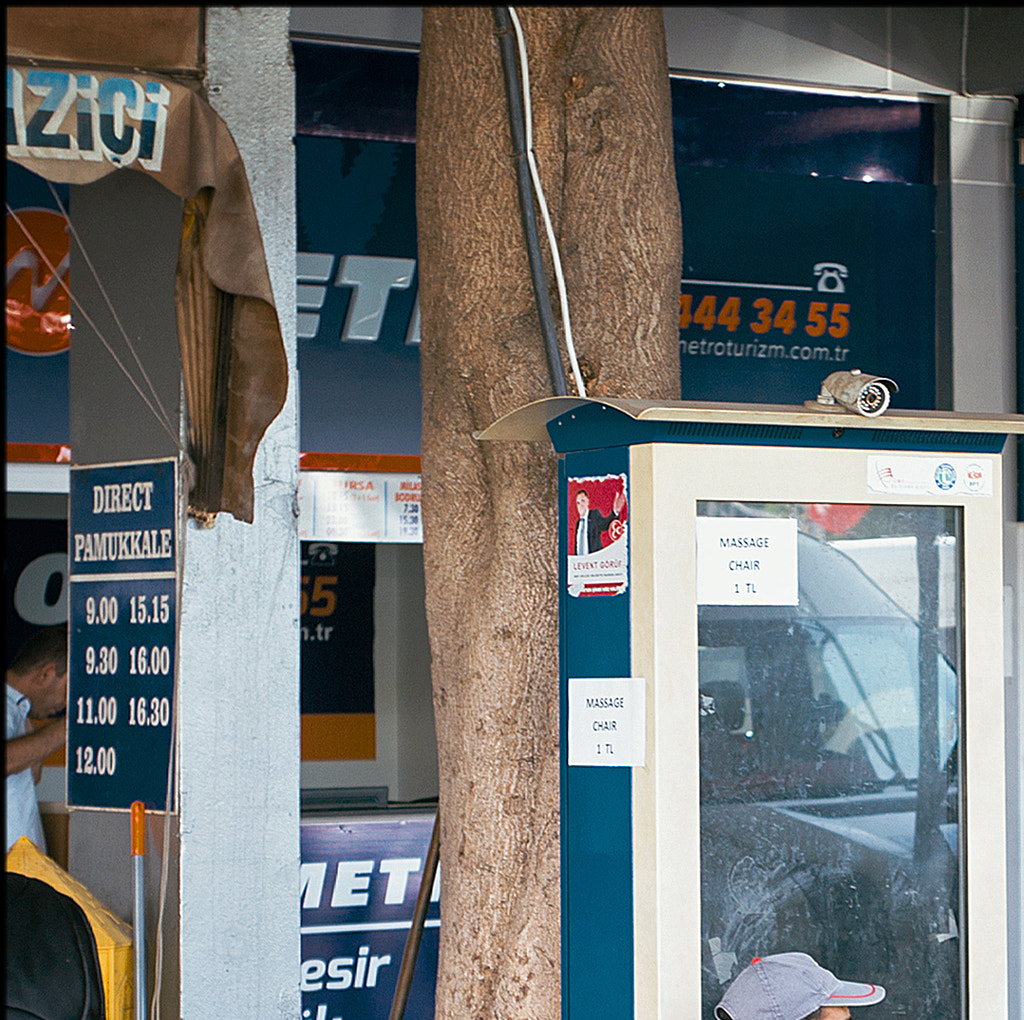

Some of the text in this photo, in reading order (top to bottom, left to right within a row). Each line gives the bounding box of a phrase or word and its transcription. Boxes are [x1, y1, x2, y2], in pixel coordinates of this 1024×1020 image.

[750, 297, 797, 334] 34
[805, 301, 851, 338] 55
[92, 481, 154, 515] DIRECT
[74, 528, 172, 563] PAMUKKALE
[719, 537, 769, 548] MASSAGE
[728, 560, 761, 571] CHAIR
[745, 583, 757, 593] TL
[86, 594, 170, 626] 9.00 15.15
[85, 646, 170, 675] 9.30 16.00
[76, 696, 170, 727] 11.00 16.30
[586, 697, 624, 708] MASSAGE
[592, 720, 617, 731] CHAIR
[76, 746, 116, 776] 12.00
